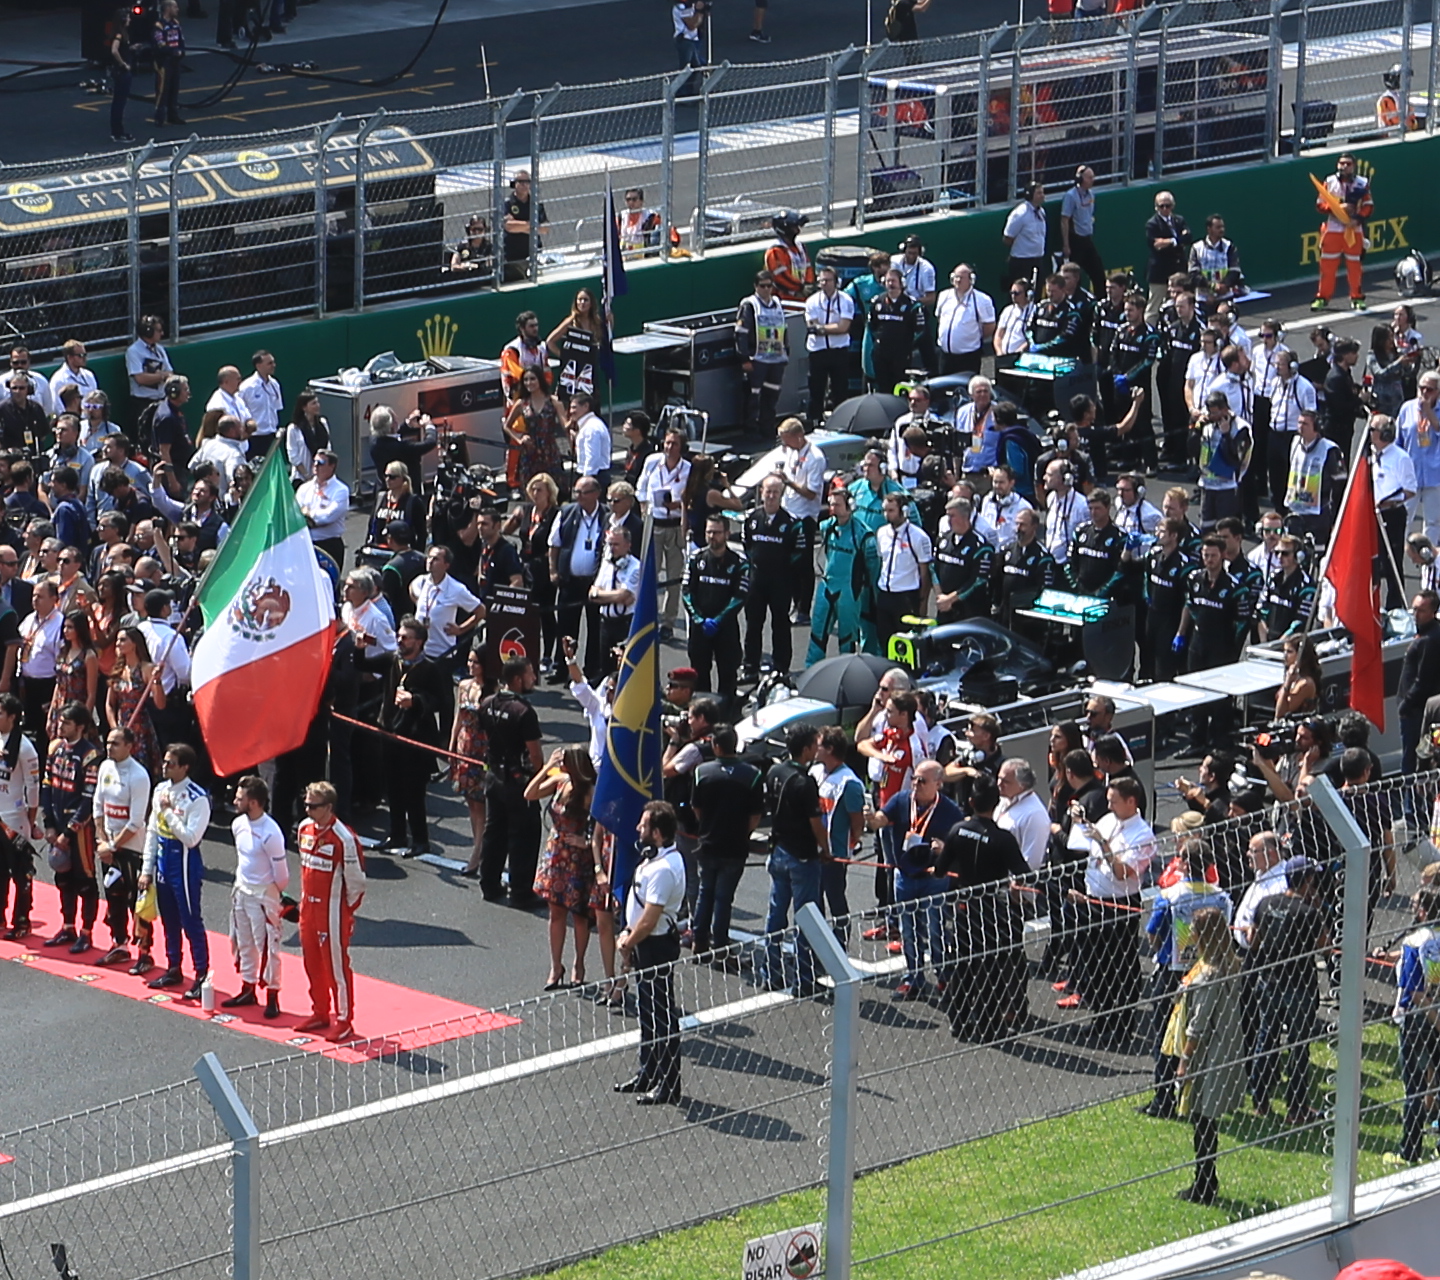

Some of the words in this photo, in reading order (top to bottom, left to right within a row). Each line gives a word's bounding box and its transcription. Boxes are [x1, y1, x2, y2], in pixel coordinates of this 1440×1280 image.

[77, 190, 107, 208] F1
[1300, 216, 1410, 265] REX
[499, 627, 527, 667] 6
[746, 1245, 766, 1263] NO
